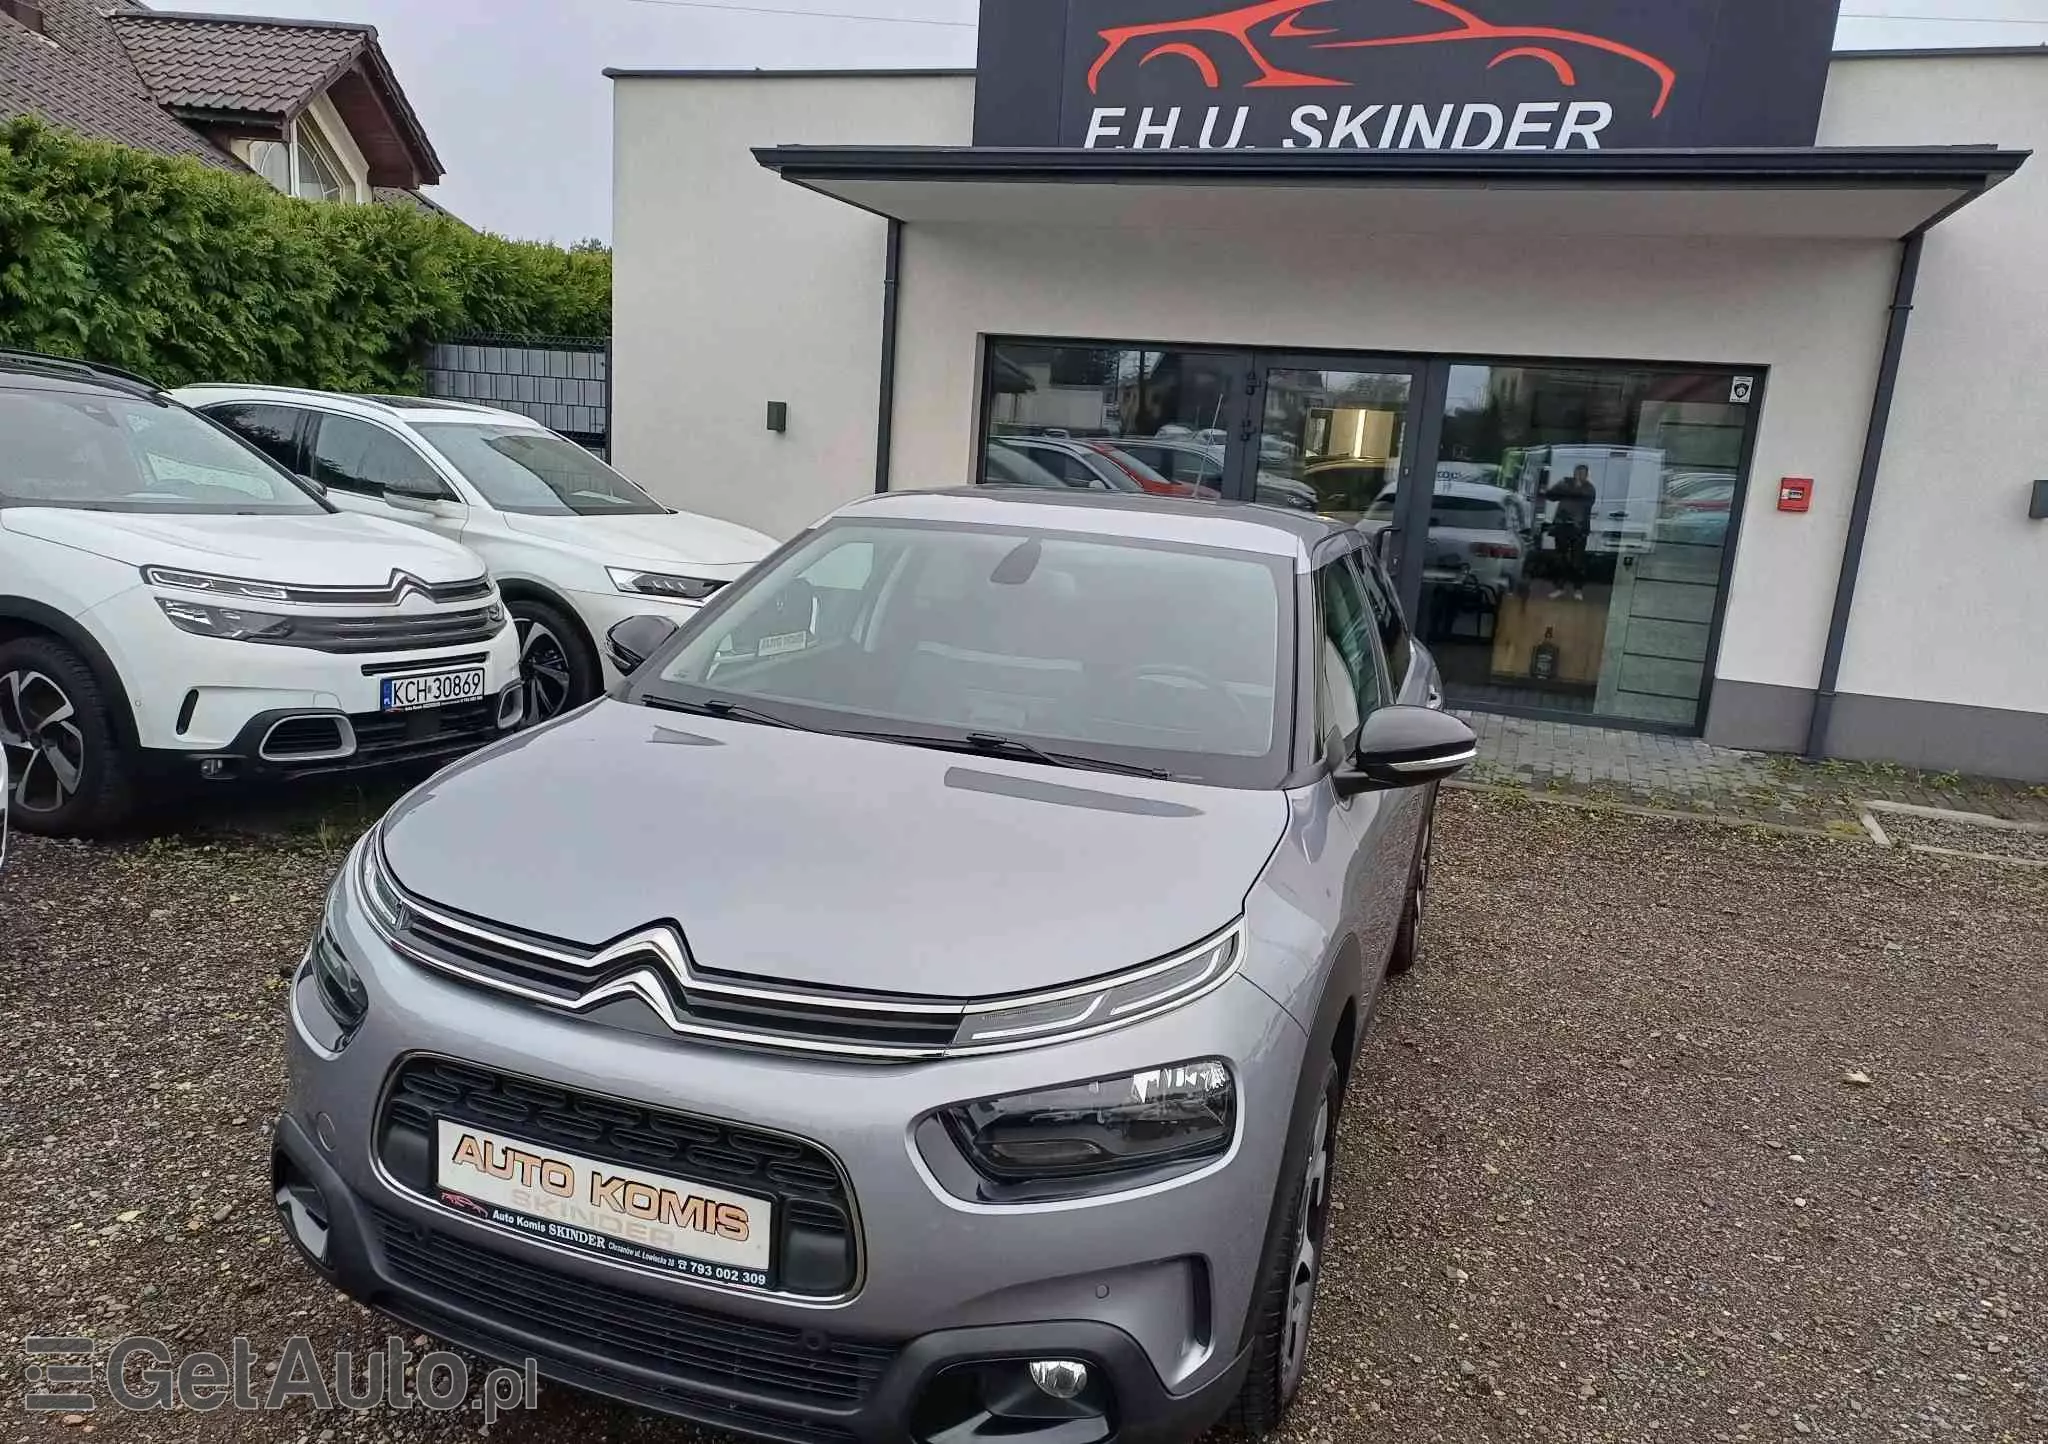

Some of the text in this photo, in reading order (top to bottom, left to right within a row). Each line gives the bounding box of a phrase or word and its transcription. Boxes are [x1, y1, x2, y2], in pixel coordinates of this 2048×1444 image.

[1282, 101, 1612, 149] SKINDER
[394, 680, 427, 705] KCH
[433, 673, 480, 699] 30869
[452, 1134, 750, 1242] AUTO KOMIS
[492, 1209, 515, 1224] Auto
[516, 1216, 546, 1233] Komis
[548, 1223, 606, 1249] SKINDER
[691, 1262, 713, 1276] 793
[716, 1267, 739, 1281] 002
[742, 1271, 766, 1285] 309
